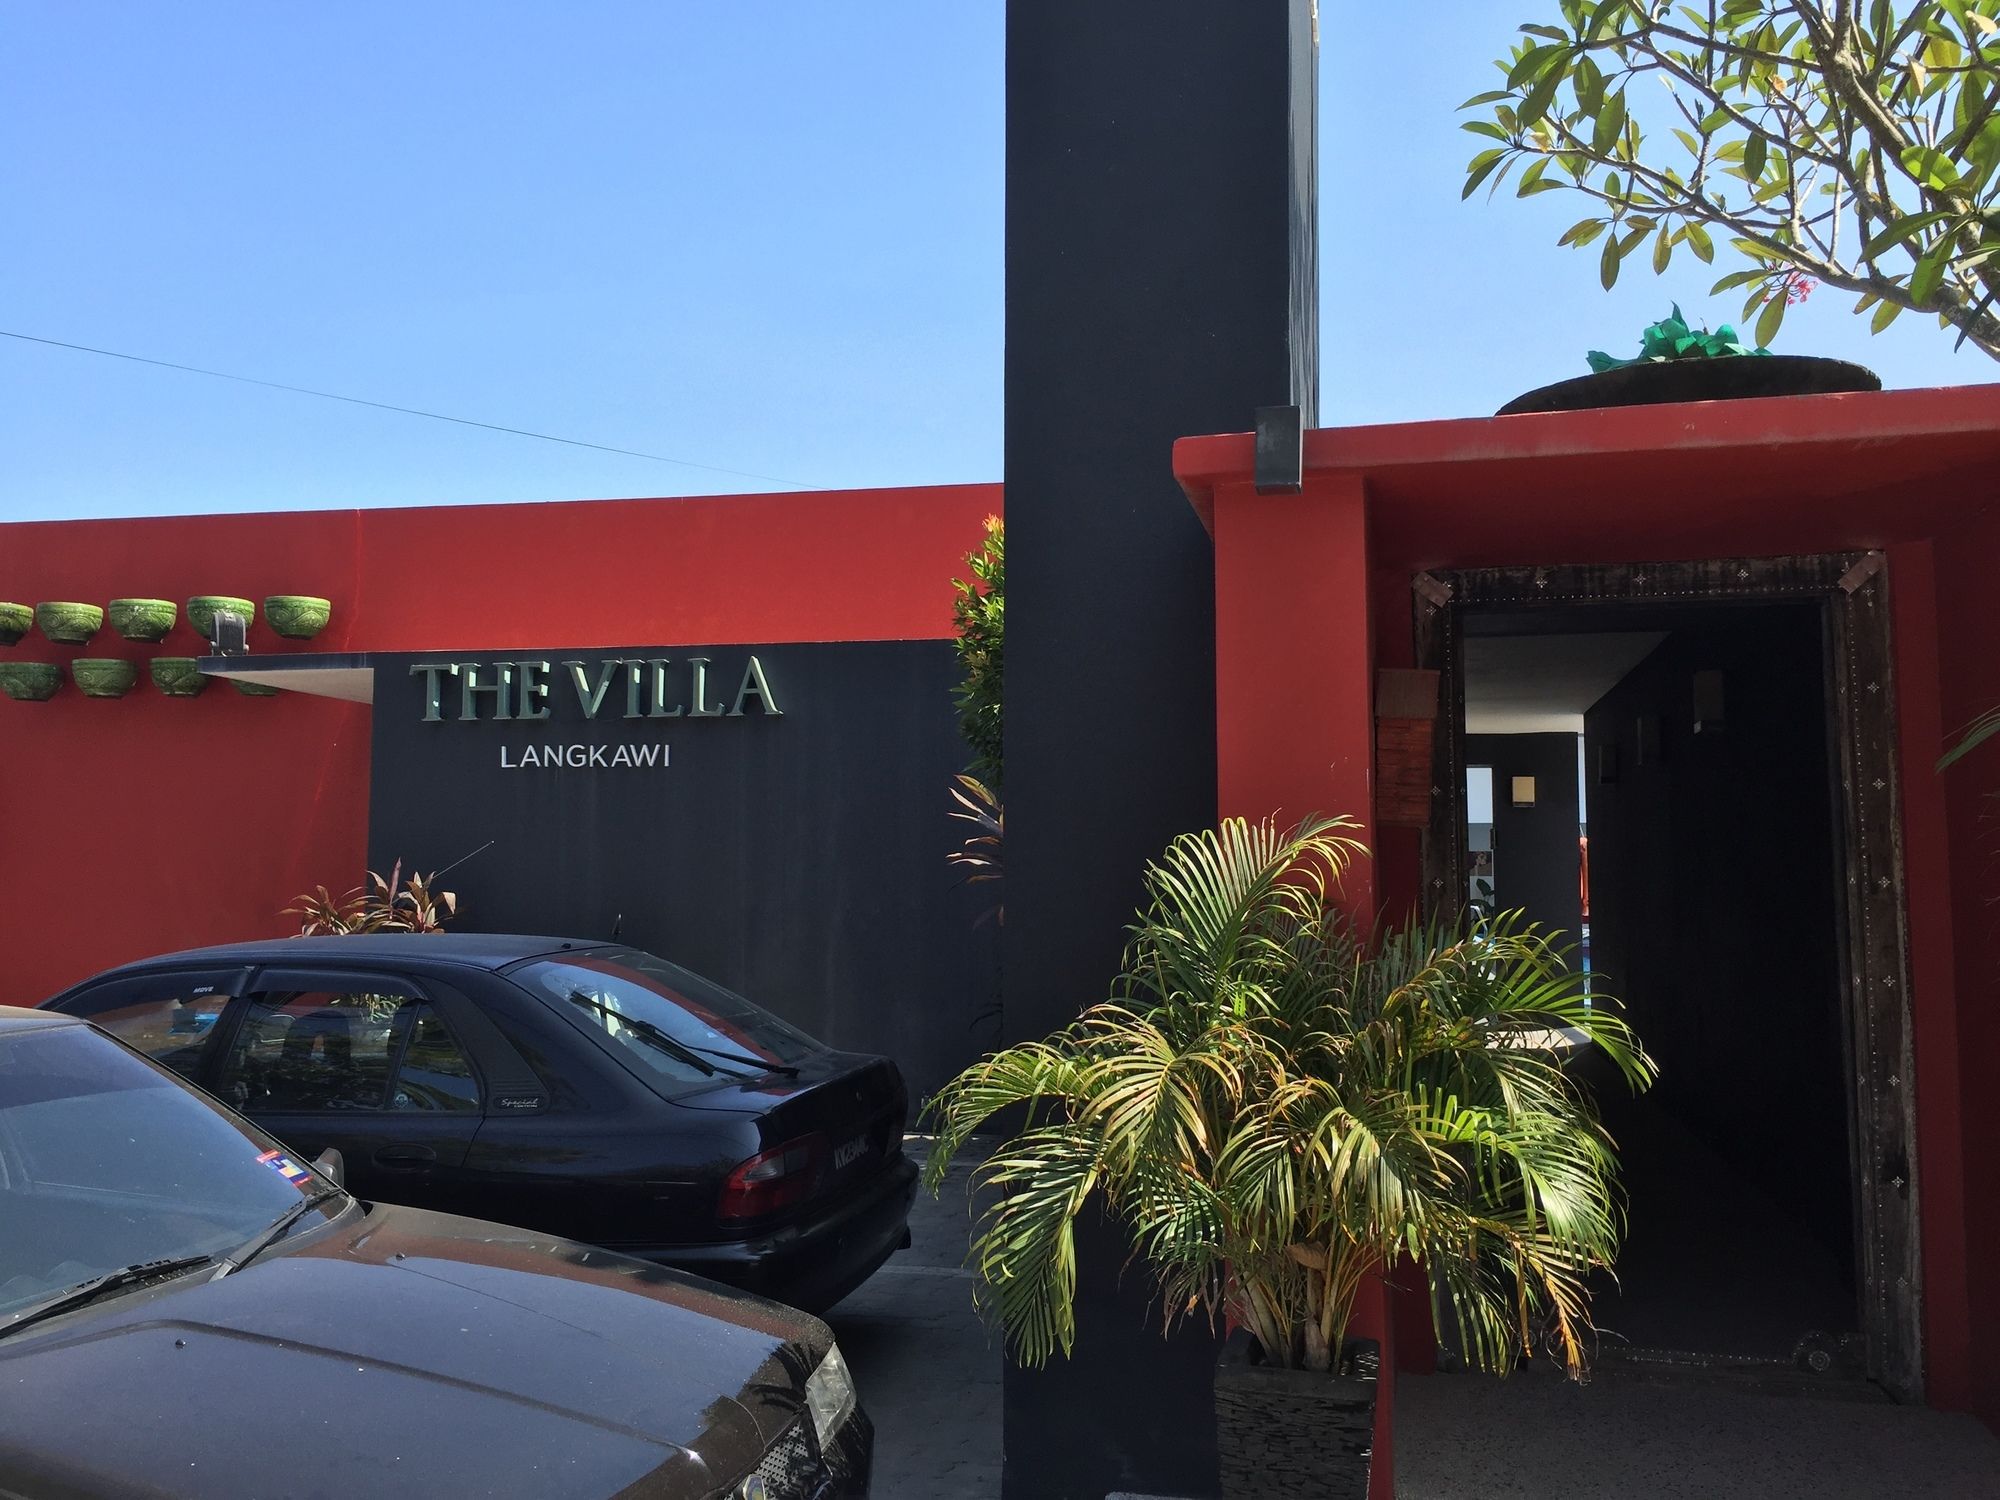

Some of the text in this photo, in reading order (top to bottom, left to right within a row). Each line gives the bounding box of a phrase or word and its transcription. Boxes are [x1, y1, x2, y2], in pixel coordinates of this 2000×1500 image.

[409, 655, 784, 721] THE VILLA
[500, 744, 671, 768] LANGKAWI
[501, 1098, 538, 1106] Special
